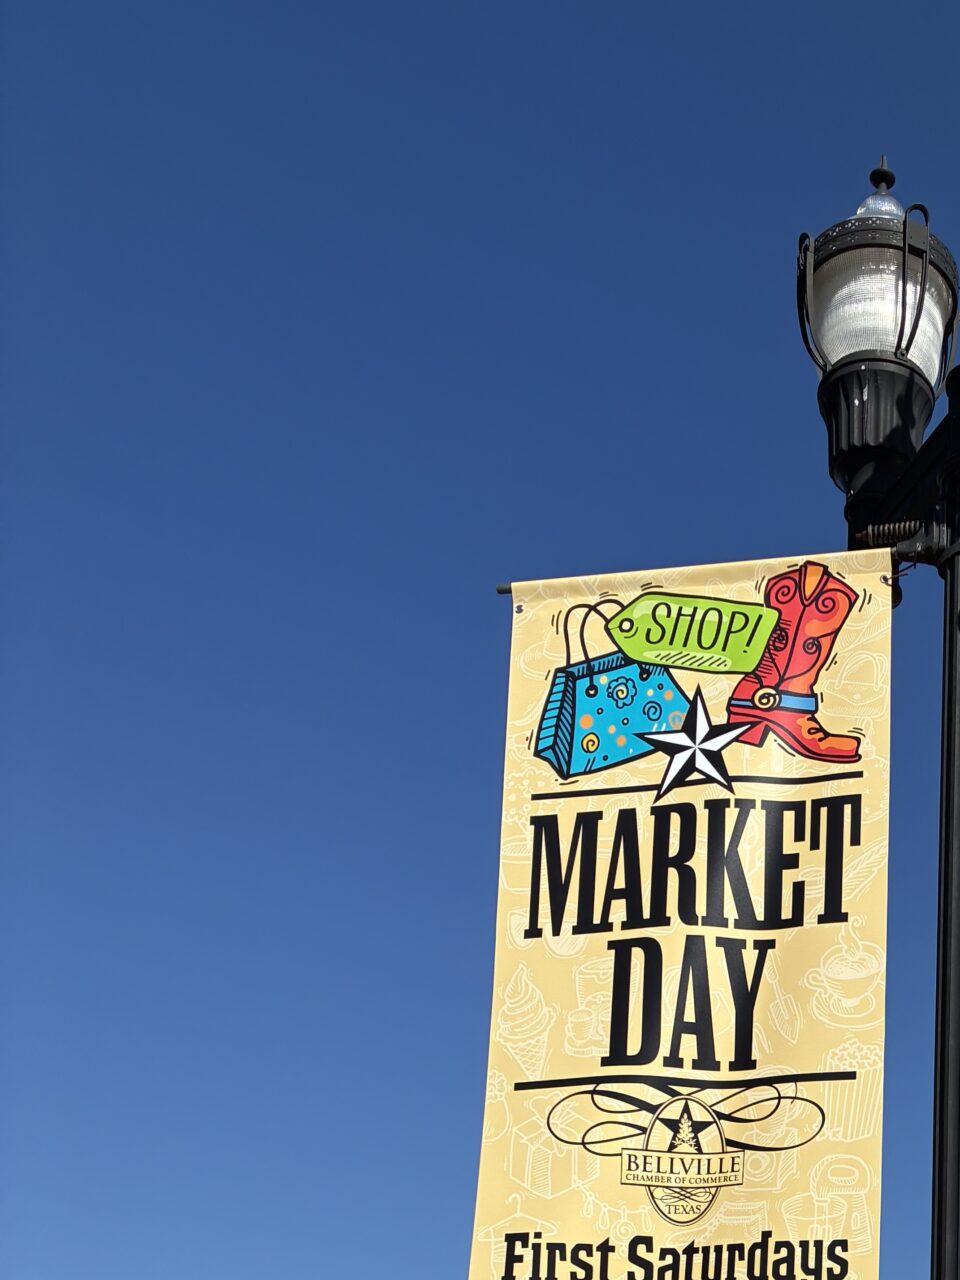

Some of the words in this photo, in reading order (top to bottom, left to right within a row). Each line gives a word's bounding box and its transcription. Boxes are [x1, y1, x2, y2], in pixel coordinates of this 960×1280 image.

[645, 601, 763, 655] SHOP!
[523, 793, 862, 940] MARKET
[599, 934, 776, 1072] DAY
[625, 1173, 672, 1184] CHAMBER
[674, 1177, 687, 1185] OF
[688, 1175, 739, 1185] COMMERCE
[626, 1153, 741, 1176] BELLVILLE
[666, 1204, 702, 1215] TEXAS
